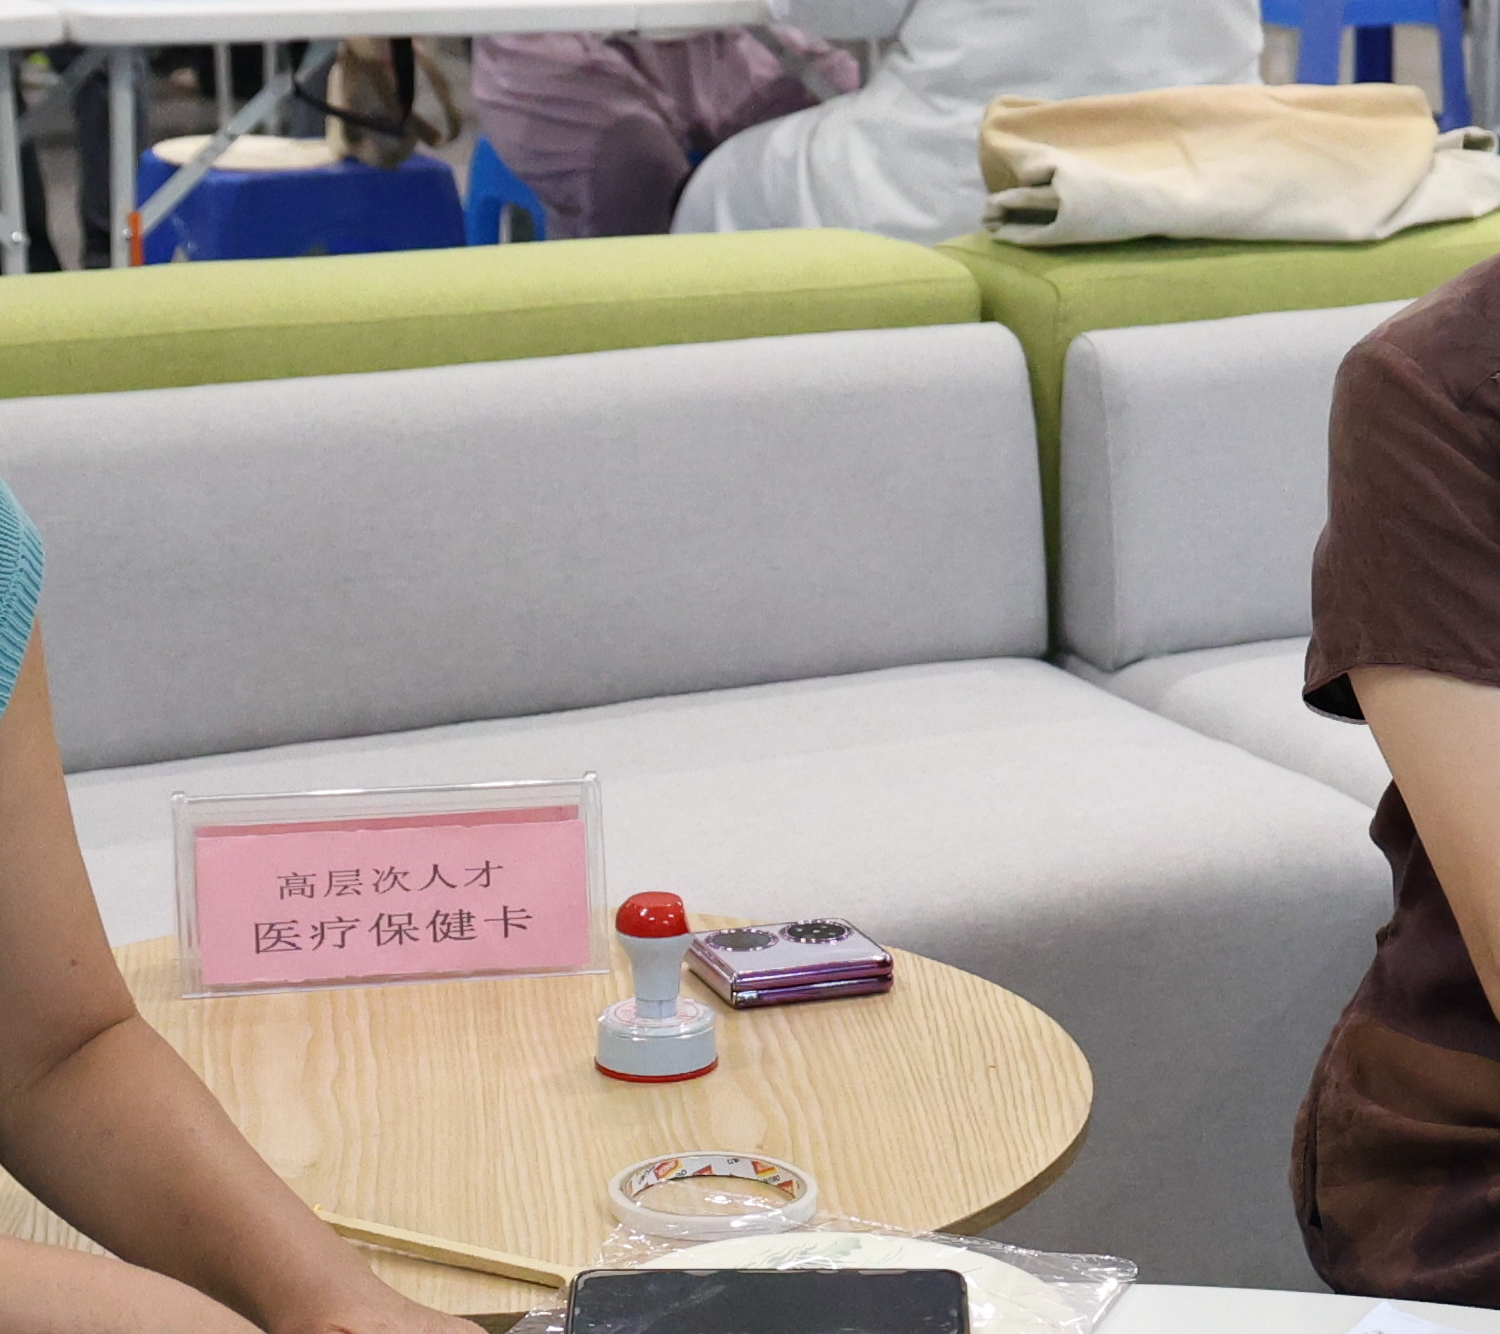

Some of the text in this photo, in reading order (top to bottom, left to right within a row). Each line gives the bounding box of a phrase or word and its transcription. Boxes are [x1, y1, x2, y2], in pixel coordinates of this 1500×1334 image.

[276, 859, 504, 901] 高层次人才
[254, 905, 534, 955] 医疗保健卡
